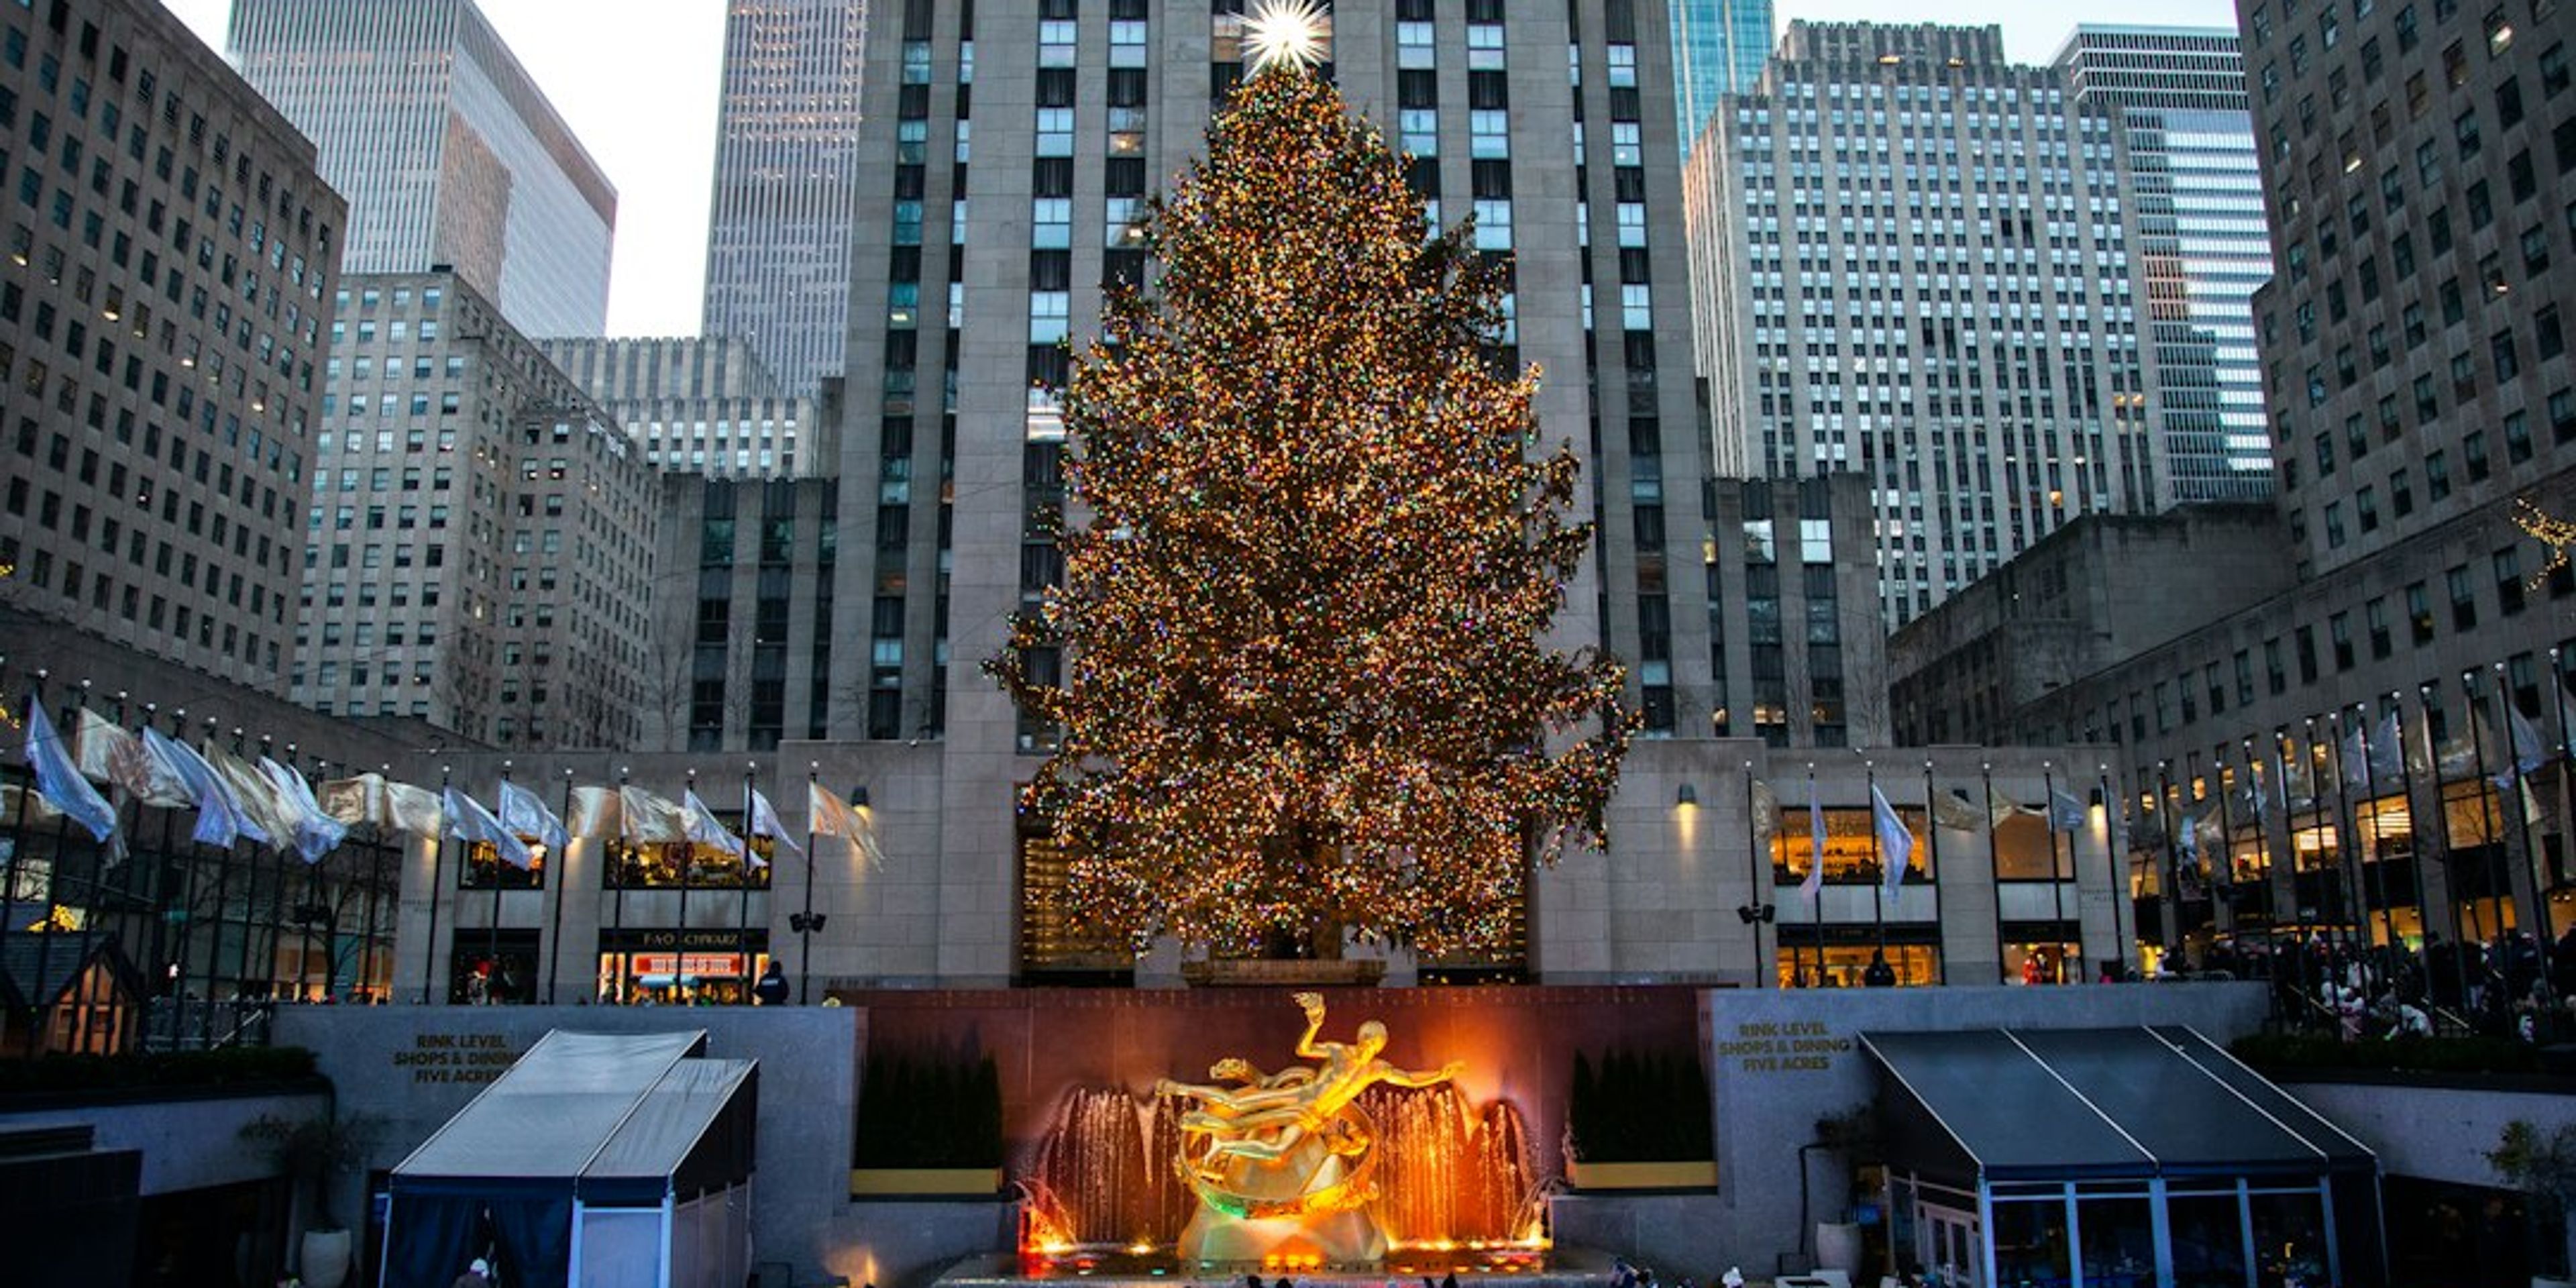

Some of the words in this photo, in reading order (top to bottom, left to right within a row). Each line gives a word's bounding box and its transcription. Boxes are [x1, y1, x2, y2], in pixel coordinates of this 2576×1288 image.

[1739, 1023, 1777, 1036] RINK
[1781, 1022, 1829, 1036] LEVEL
[417, 1034, 455, 1048] RINK
[460, 1034, 506, 1048] LEVEL
[1718, 1040, 1773, 1055] SHOPS
[1792, 1038, 1850, 1053] DINING
[393, 1051, 448, 1065] SHOPS
[468, 1051, 520, 1065] DININ
[1743, 1058, 1777, 1071] FIVE
[1782, 1057, 1830, 1070] ACRES
[415, 1069, 449, 1083] FIVE
